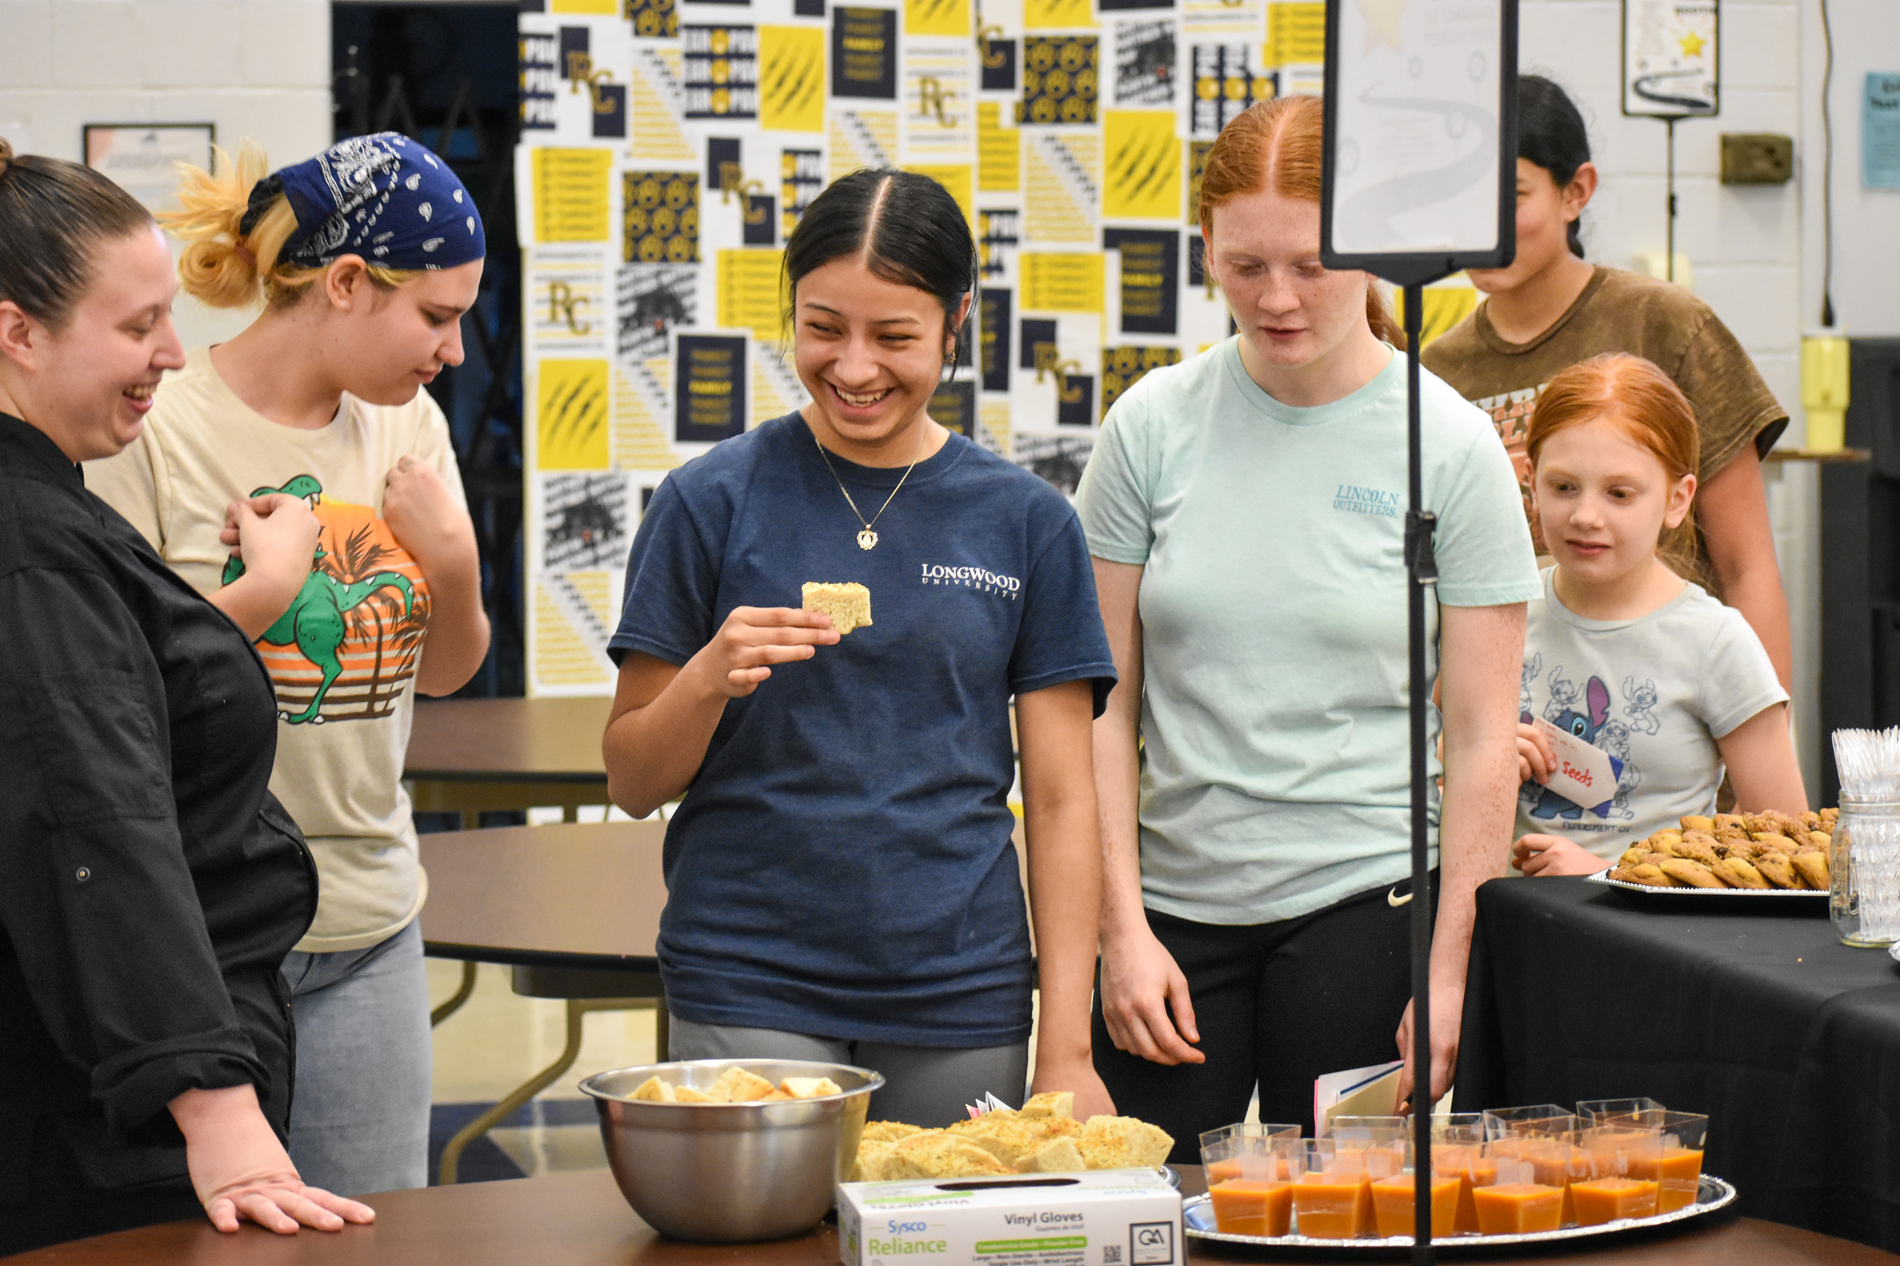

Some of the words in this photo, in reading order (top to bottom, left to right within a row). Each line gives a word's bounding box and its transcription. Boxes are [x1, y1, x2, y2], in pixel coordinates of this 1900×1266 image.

[1335, 485, 1400, 506] LINCOLN
[1333, 499, 1396, 516] OUTFITTERS
[922, 563, 1021, 591] LONGWOOD
[922, 577, 1018, 600] UNIVERSITY
[1562, 761, 1593, 787] Seeds
[888, 1219, 927, 1235] Sysco
[1005, 1213, 1037, 1227] Vinyl
[1041, 1211, 1084, 1224] Gloves
[868, 1237, 947, 1256] Reliance
